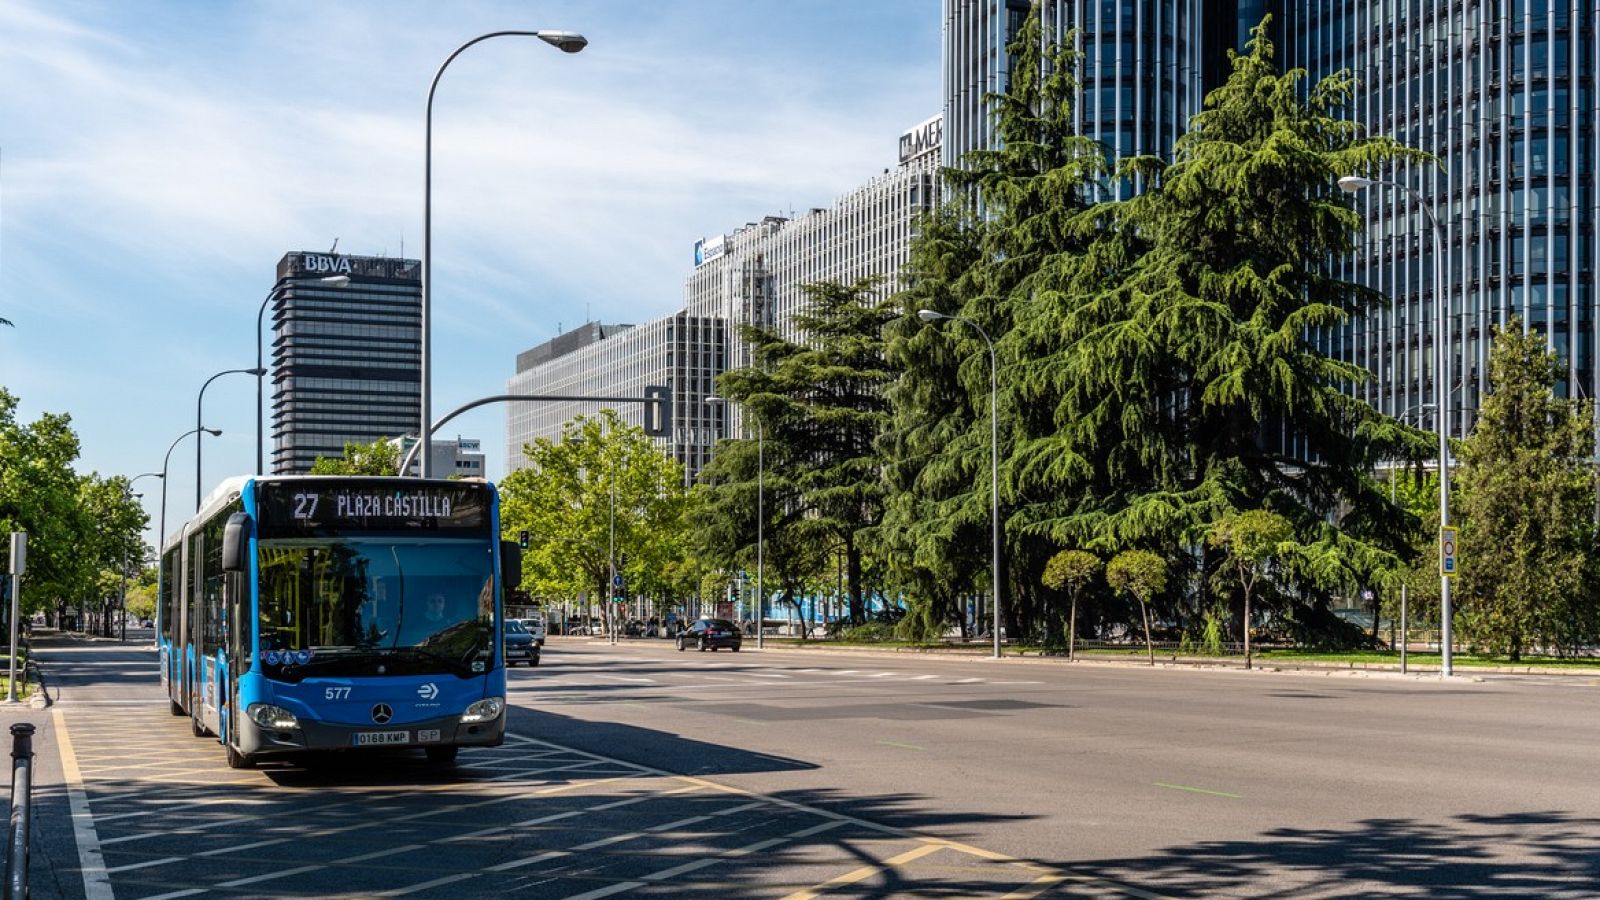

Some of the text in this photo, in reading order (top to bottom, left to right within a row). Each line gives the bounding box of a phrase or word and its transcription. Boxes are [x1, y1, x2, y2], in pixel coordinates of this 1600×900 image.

[305, 255, 352, 273] BBVA
[294, 493, 450, 519] 27 PLAZA CASTILLA
[325, 687, 352, 700] 577
